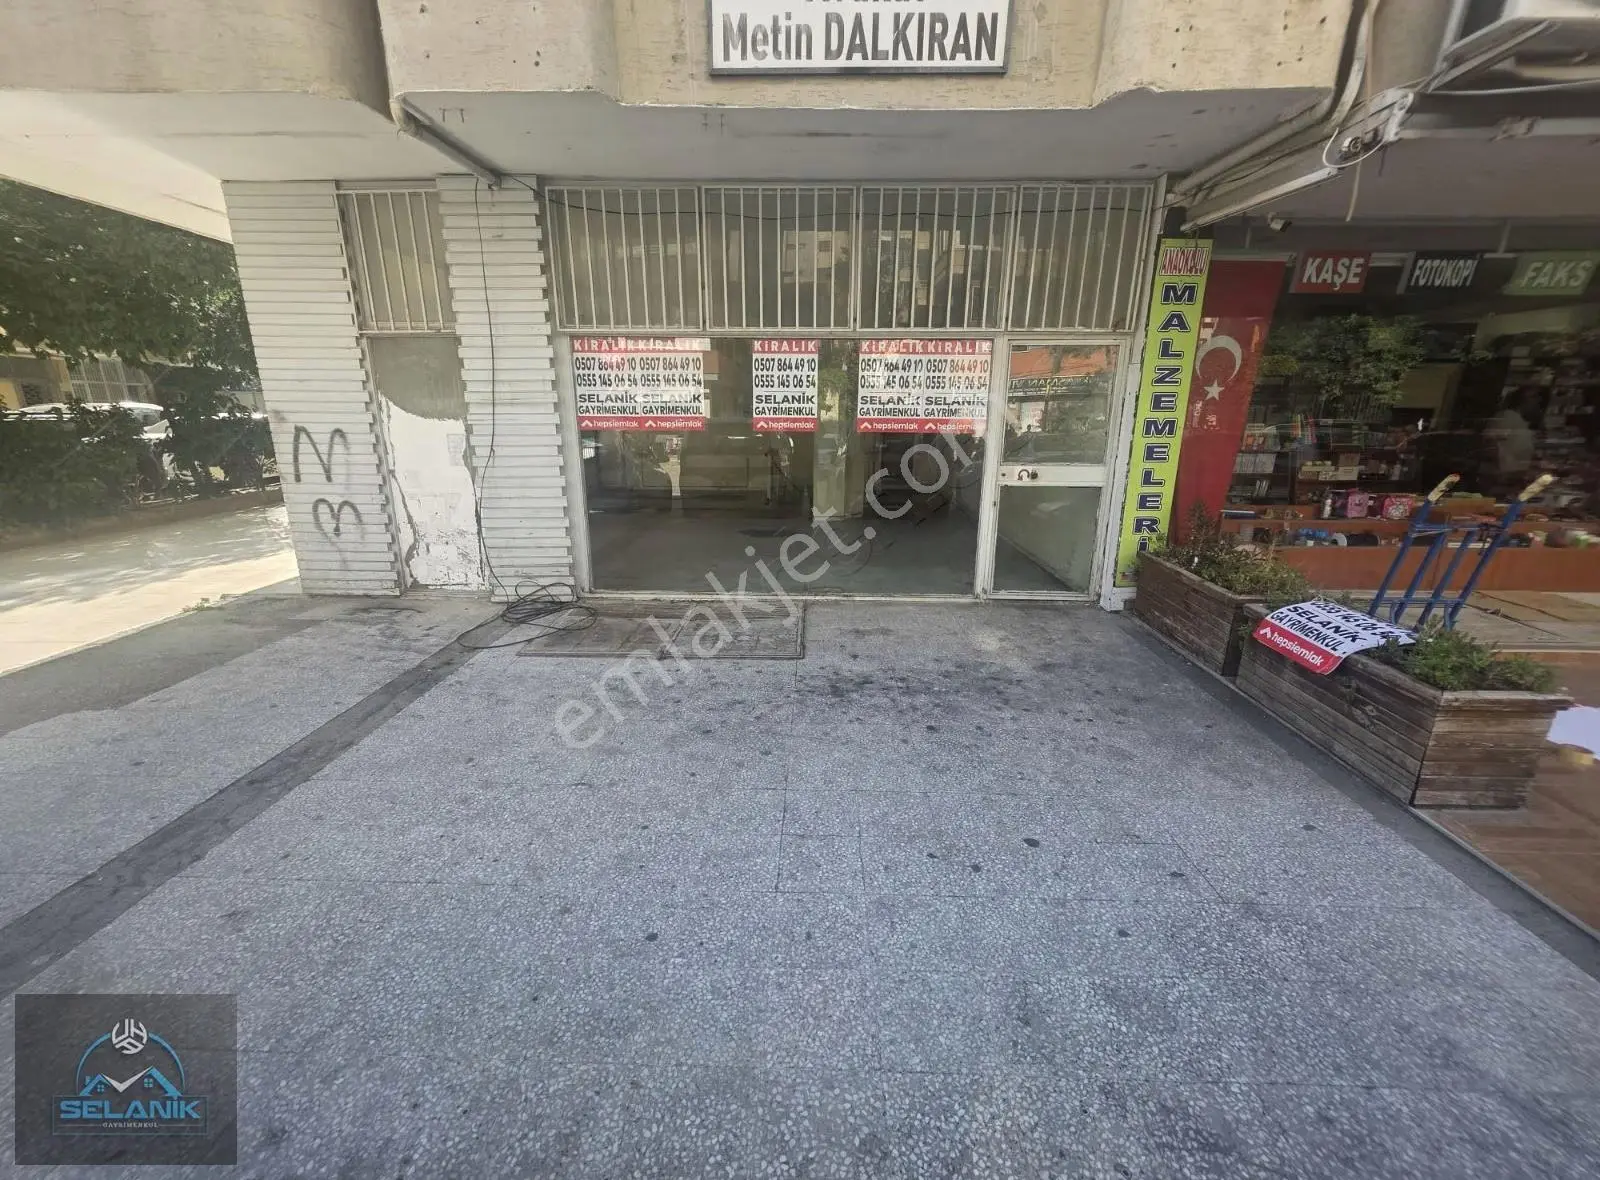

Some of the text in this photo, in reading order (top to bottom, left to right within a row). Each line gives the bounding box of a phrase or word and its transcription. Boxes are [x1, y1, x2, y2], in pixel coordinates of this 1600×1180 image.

[722, 11, 1000, 62] Metin DALKIRAN
[1302, 256, 1365, 290] KAŞE
[1519, 259, 1594, 289] FAKS
[575, 357, 595, 370] 0507
[627, 357, 637, 371] 10
[640, 357, 701, 370] 0507 864 49 10
[754, 357, 817, 372] 0507 864 49 10
[901, 358, 912, 372] 49
[926, 358, 989, 373] 0507 864 49 10
[577, 373, 597, 387] 0555
[598, 373, 612, 387] 145
[641, 373, 660, 387] 0555
[679, 373, 690, 387] 06
[691, 373, 702, 387] 54
[755, 374, 816, 388] 0555 145 06 54
[899, 375, 910, 389] 06
[925, 375, 946, 389] 0555
[579, 391, 637, 403] SELANİK
[755, 392, 815, 404] SELANİK
[755, 405, 815, 416] GAYRİMENKUL
[1286, 605, 1368, 643] SELANİK
[1271, 632, 1325, 667] hepsiemlak
